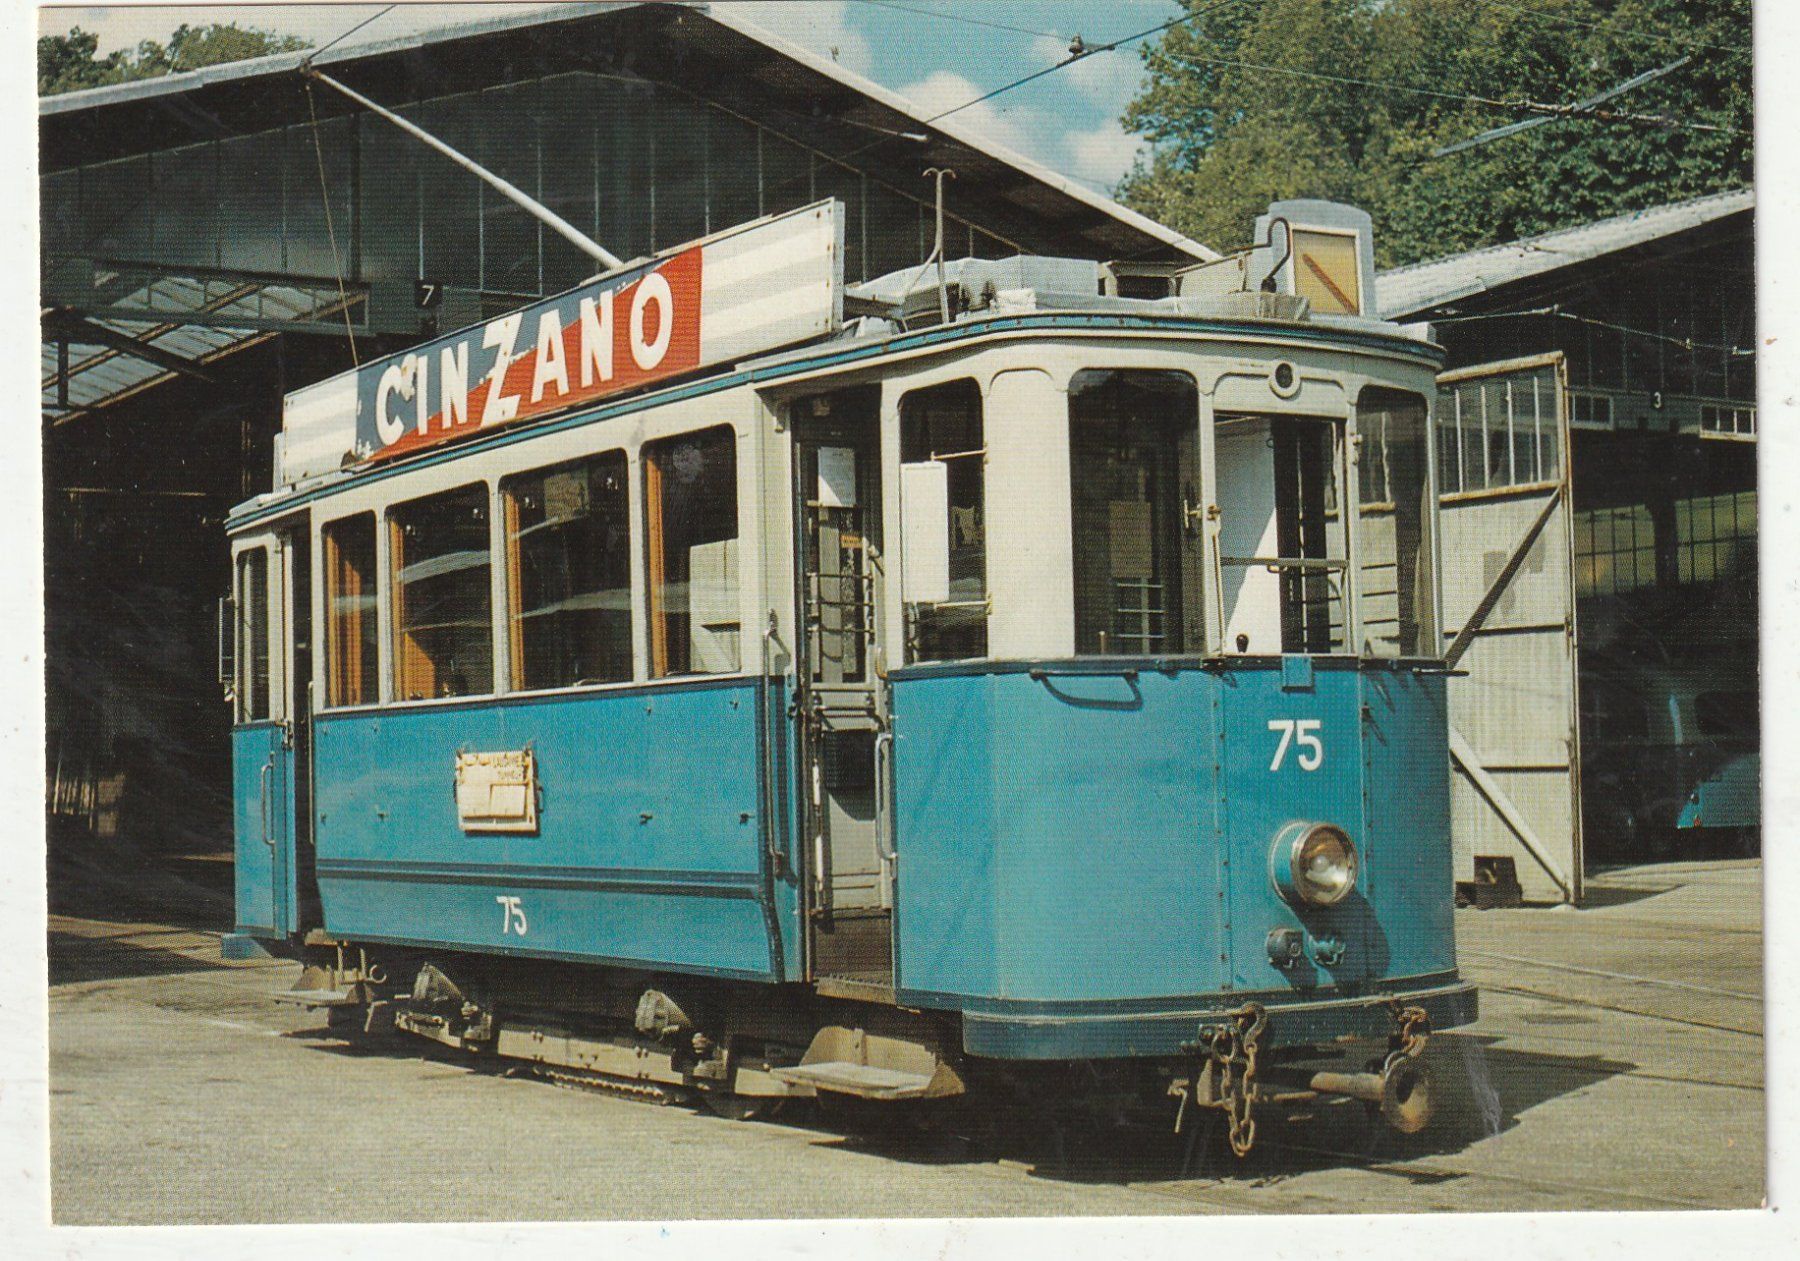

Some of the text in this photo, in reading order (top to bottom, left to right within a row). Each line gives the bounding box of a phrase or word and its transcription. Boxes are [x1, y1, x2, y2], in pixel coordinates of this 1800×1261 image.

[421, 284, 434, 305] 7
[376, 272, 673, 446] CINZANO
[1653, 391, 1662, 408] 3
[1267, 719, 1323, 771] 75
[496, 895, 527, 936] 75
